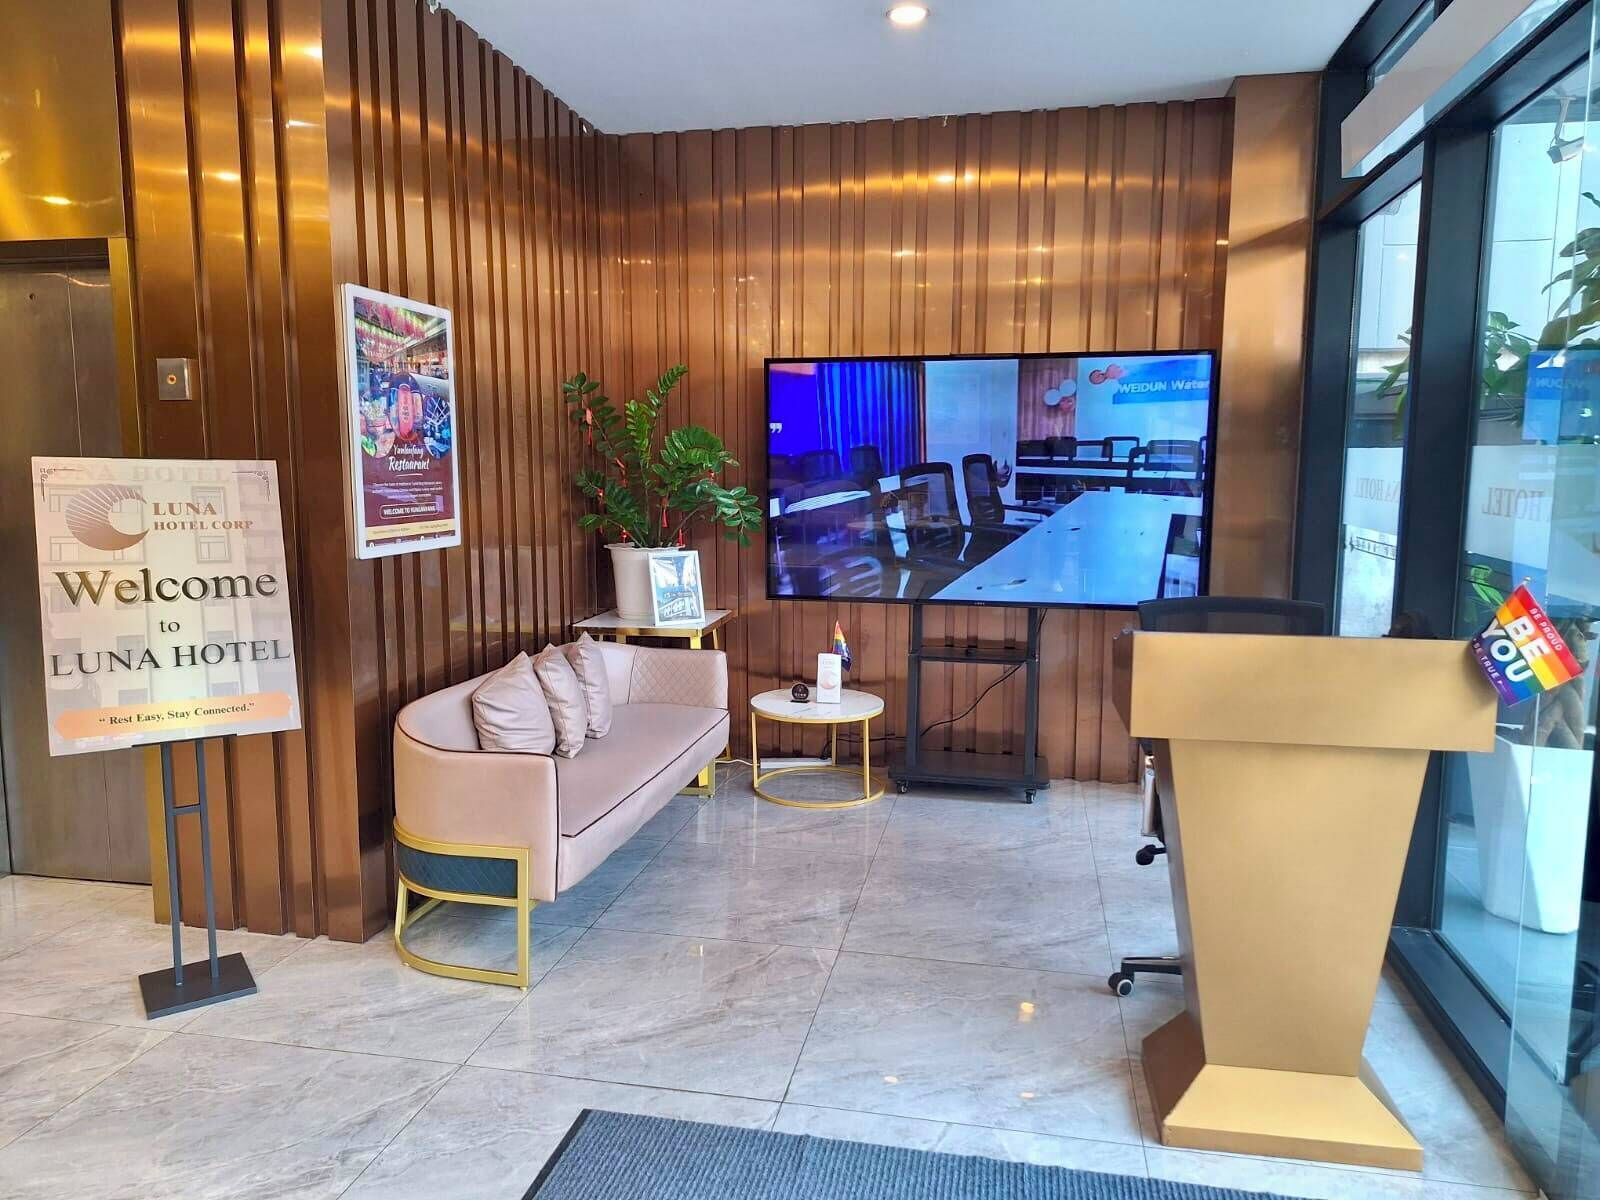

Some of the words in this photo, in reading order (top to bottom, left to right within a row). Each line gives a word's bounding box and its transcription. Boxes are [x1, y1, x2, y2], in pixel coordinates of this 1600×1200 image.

[1118, 381, 1167, 393] WEIDUN
[389, 456, 430, 472] Restaurant
[152, 501, 217, 516] LUNA
[154, 520, 210, 531] HOTEL
[212, 519, 254, 530] CORP
[53, 567, 279, 607] Welcome
[158, 619, 181, 634] to
[1528, 607, 1543, 620] BE
[1539, 622, 1564, 652] PROUD
[1504, 615, 1551, 661] BE
[49, 647, 162, 677] LUNA
[172, 638, 292, 668] HOTEL
[1482, 618, 1534, 683] YOU
[1480, 655, 1500, 679] TRUE
[109, 715, 133, 725] Rest
[136, 712, 164, 723] Easy,
[167, 710, 191, 721] Stay
